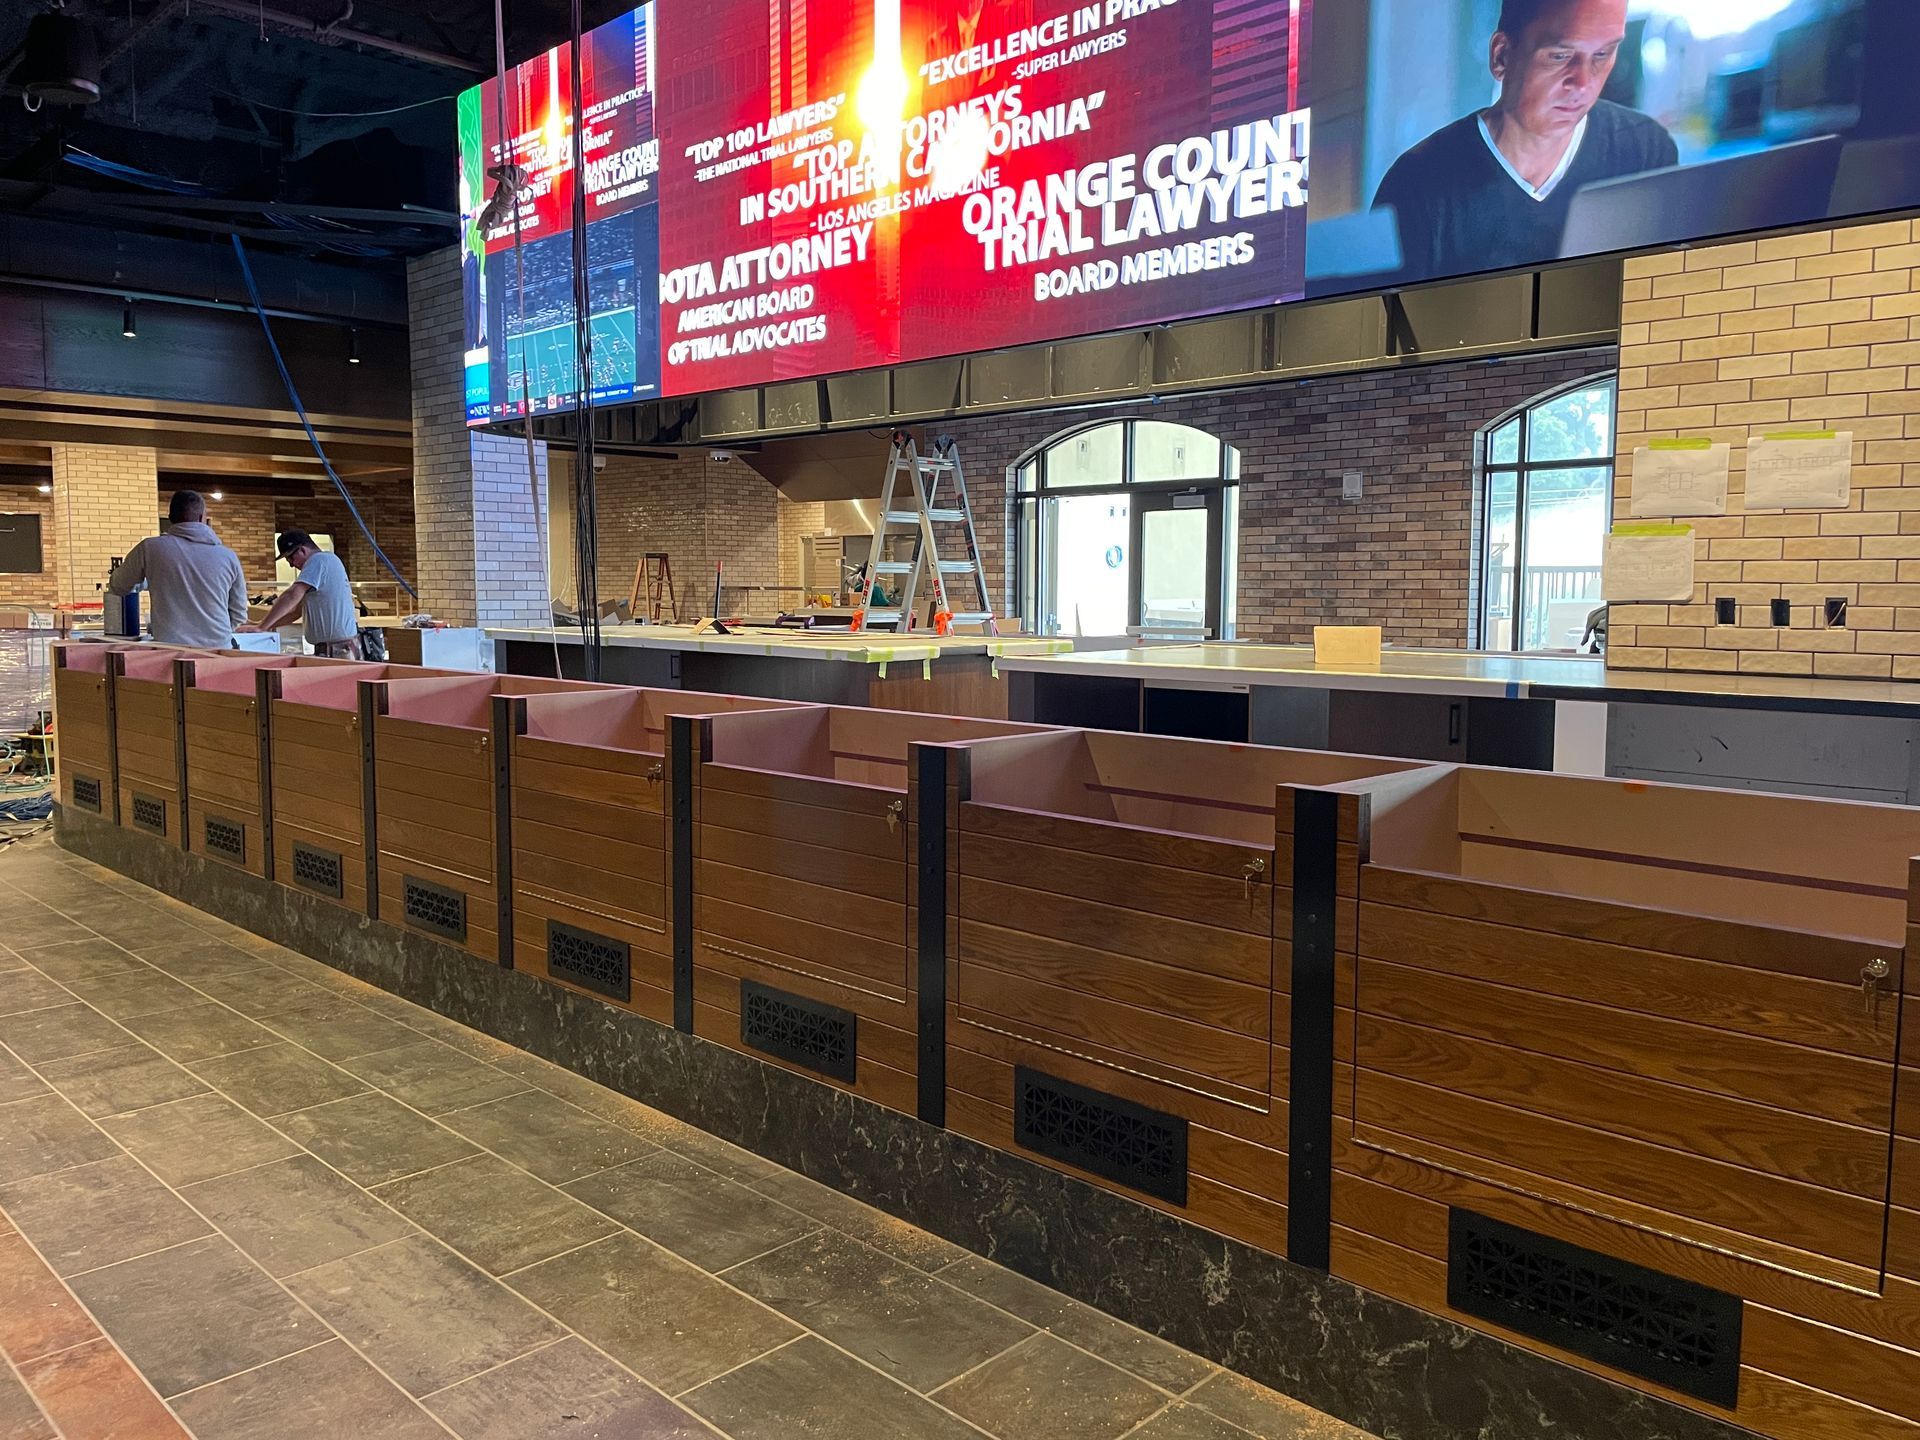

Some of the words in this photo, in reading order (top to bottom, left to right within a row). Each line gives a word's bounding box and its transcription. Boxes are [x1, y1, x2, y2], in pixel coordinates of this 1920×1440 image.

[919, 15, 1068, 85] “EXCELLENCE
[1073, 3, 1100, 36] IN
[1011, 54, 1059, 80] -SUPER
[1061, 29, 1127, 66] LAWYERS
[685, 136, 724, 164] “TOP
[726, 127, 756, 153] 100
[757, 93, 846, 144] LAWYERS”
[715, 151, 761, 177] NATIONAL
[760, 143, 788, 162] TRIAL
[788, 127, 834, 154] LAWYERS
[739, 193, 764, 225] IN
[906, 91, 1106, 178] CAORNIA”
[793, 139, 853, 179] “TOP
[857, 85, 1023, 168] AORNEYS
[846, 190, 911, 224] ANGELES
[962, 153, 1135, 237] ORANGE
[1143, 107, 1311, 192] COUNT
[718, 222, 874, 293] ATTORNEY
[977, 209, 1094, 271] TRIAL
[1034, 259, 1118, 301] BOARD
[1120, 231, 1255, 286] MEMBERS
[668, 340, 688, 365] OF
[687, 334, 731, 360] TRIAL
[731, 315, 826, 354] ADVOCATES
[677, 296, 755, 333] AMERICAN
[757, 284, 814, 317] BOARD
